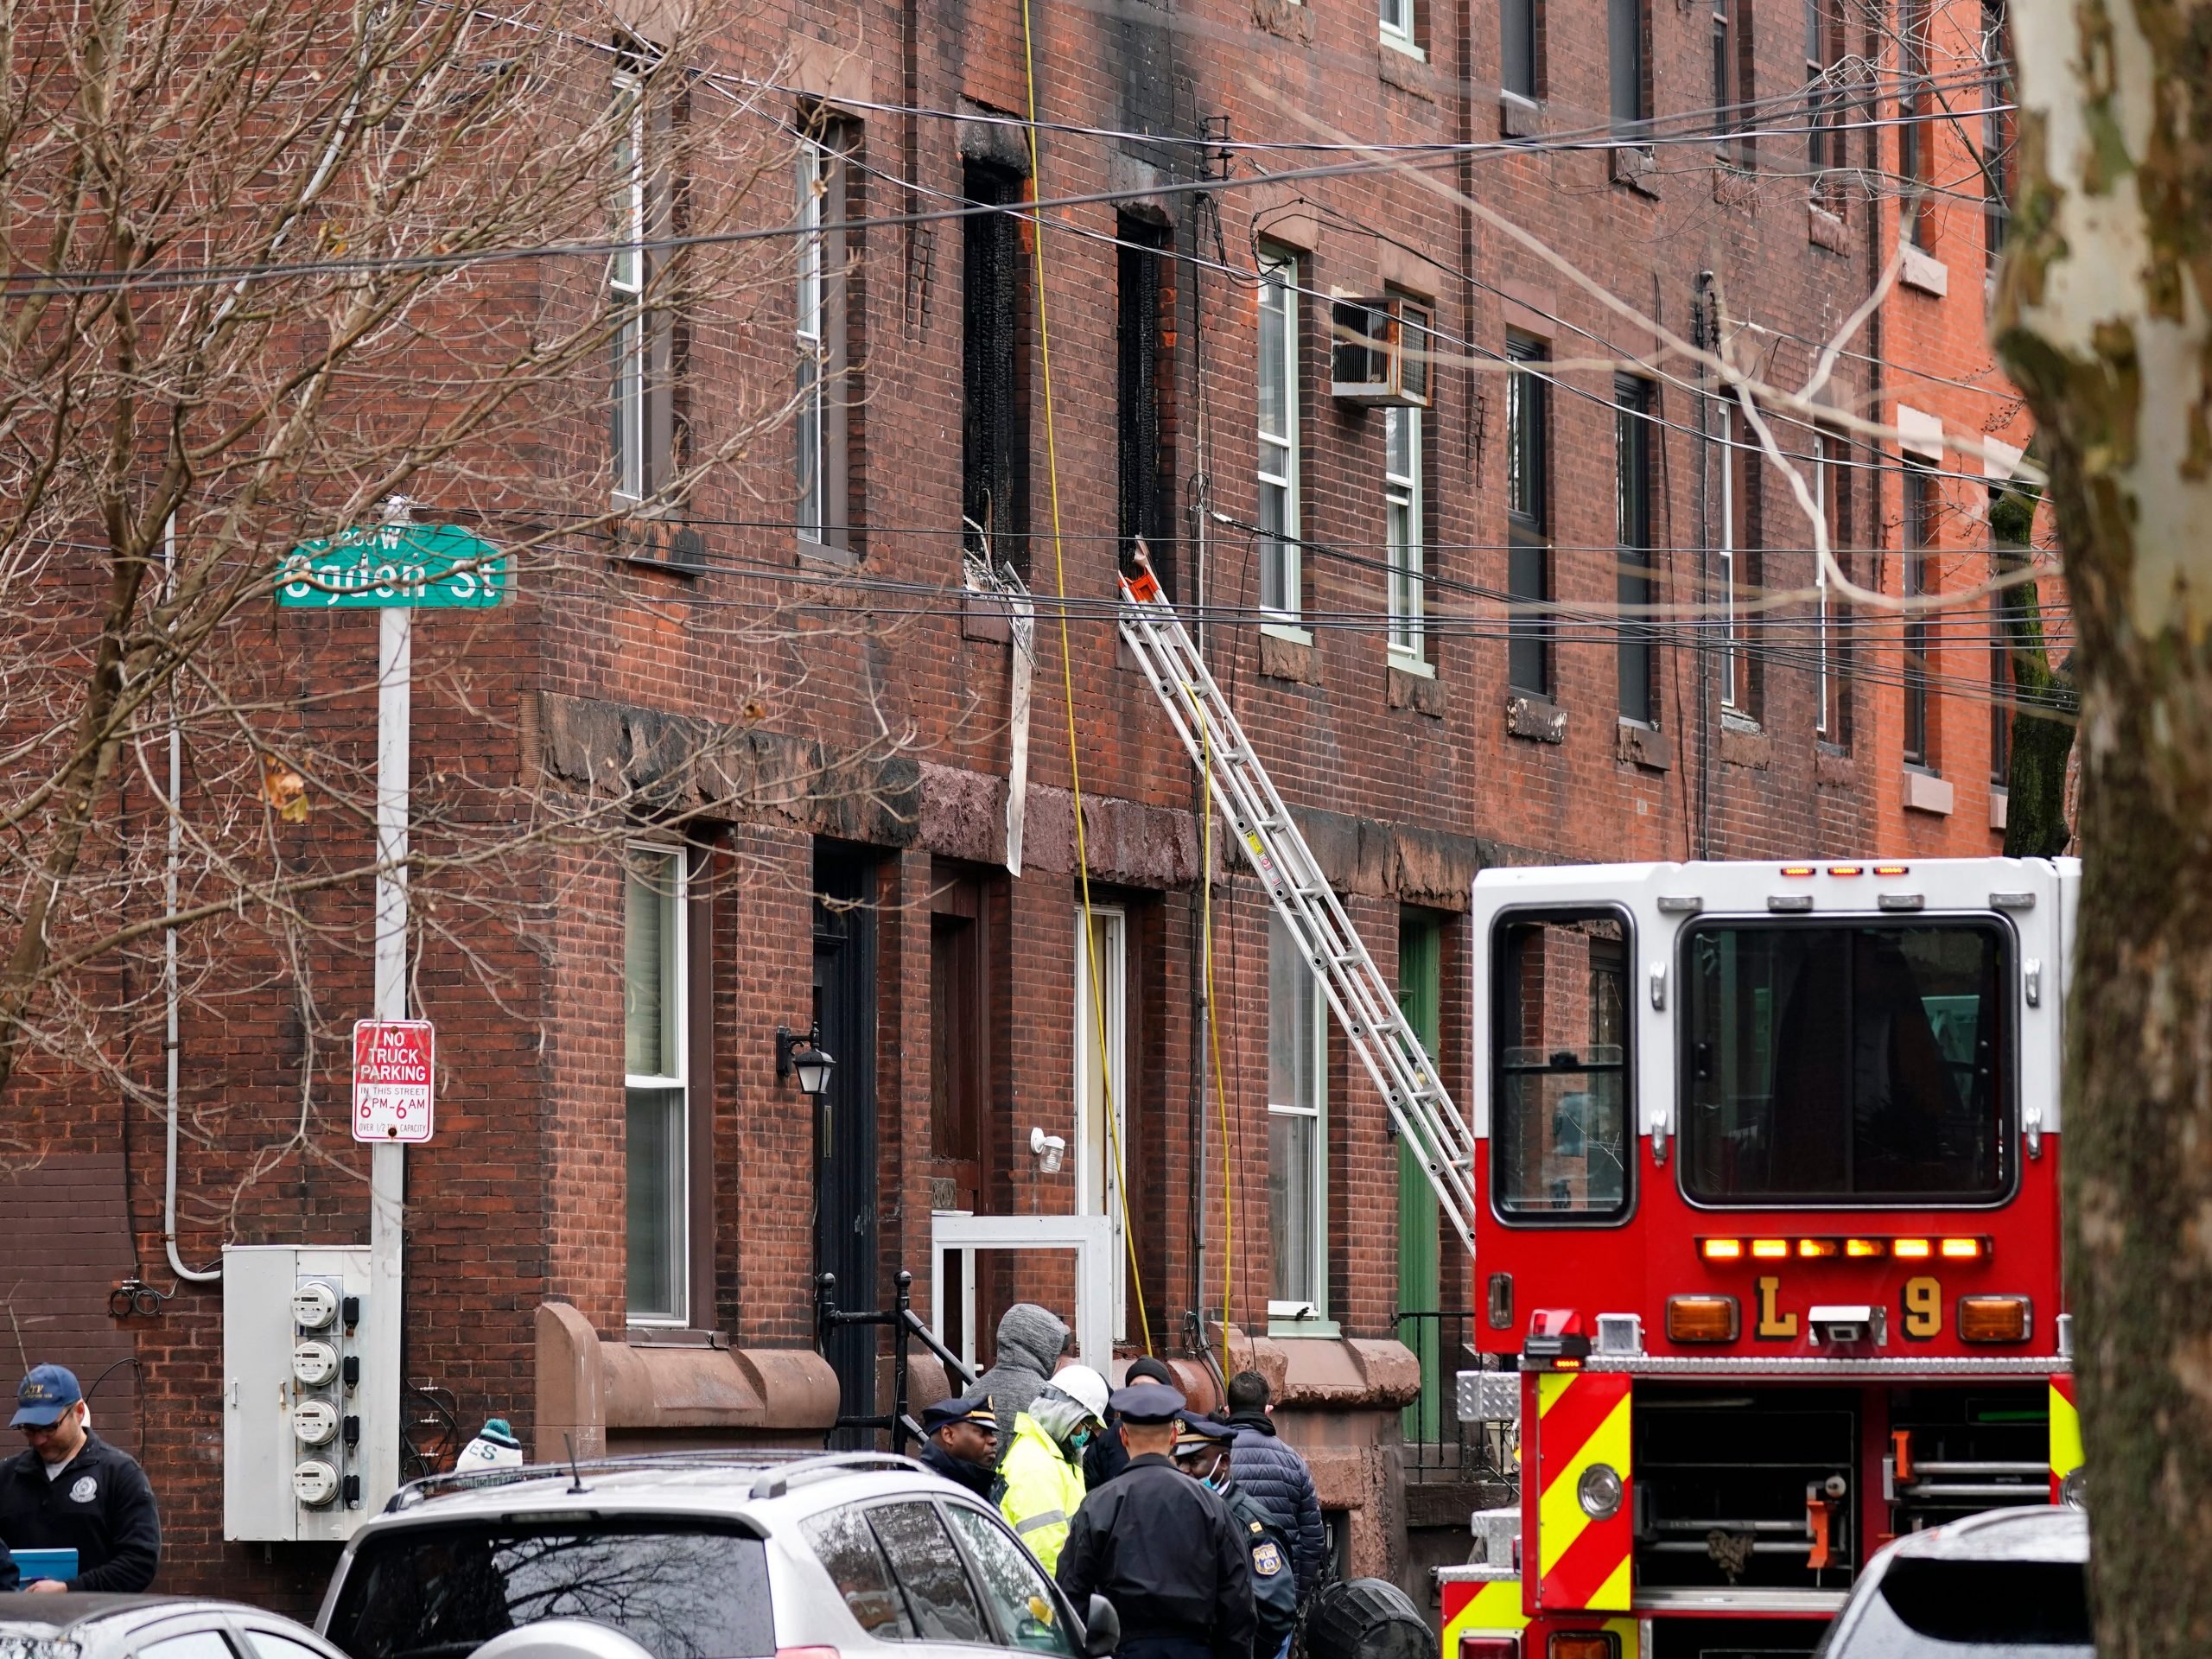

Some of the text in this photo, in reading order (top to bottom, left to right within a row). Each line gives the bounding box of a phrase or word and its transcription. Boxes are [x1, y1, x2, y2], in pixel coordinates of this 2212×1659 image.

[381, 528, 401, 550] W
[284, 552, 496, 605] Ogden St
[383, 1031, 404, 1047] NO
[368, 1048, 419, 1064] TRUCK
[360, 1065, 426, 1082] PARKING
[360, 1086, 425, 1096] IN THIS STREET
[359, 1122, 374, 1132] OVER
[377, 1122, 385, 1132] 1/2
[400, 1123, 427, 1134] CAPACITY
[1758, 1276, 1942, 1338] L 9
